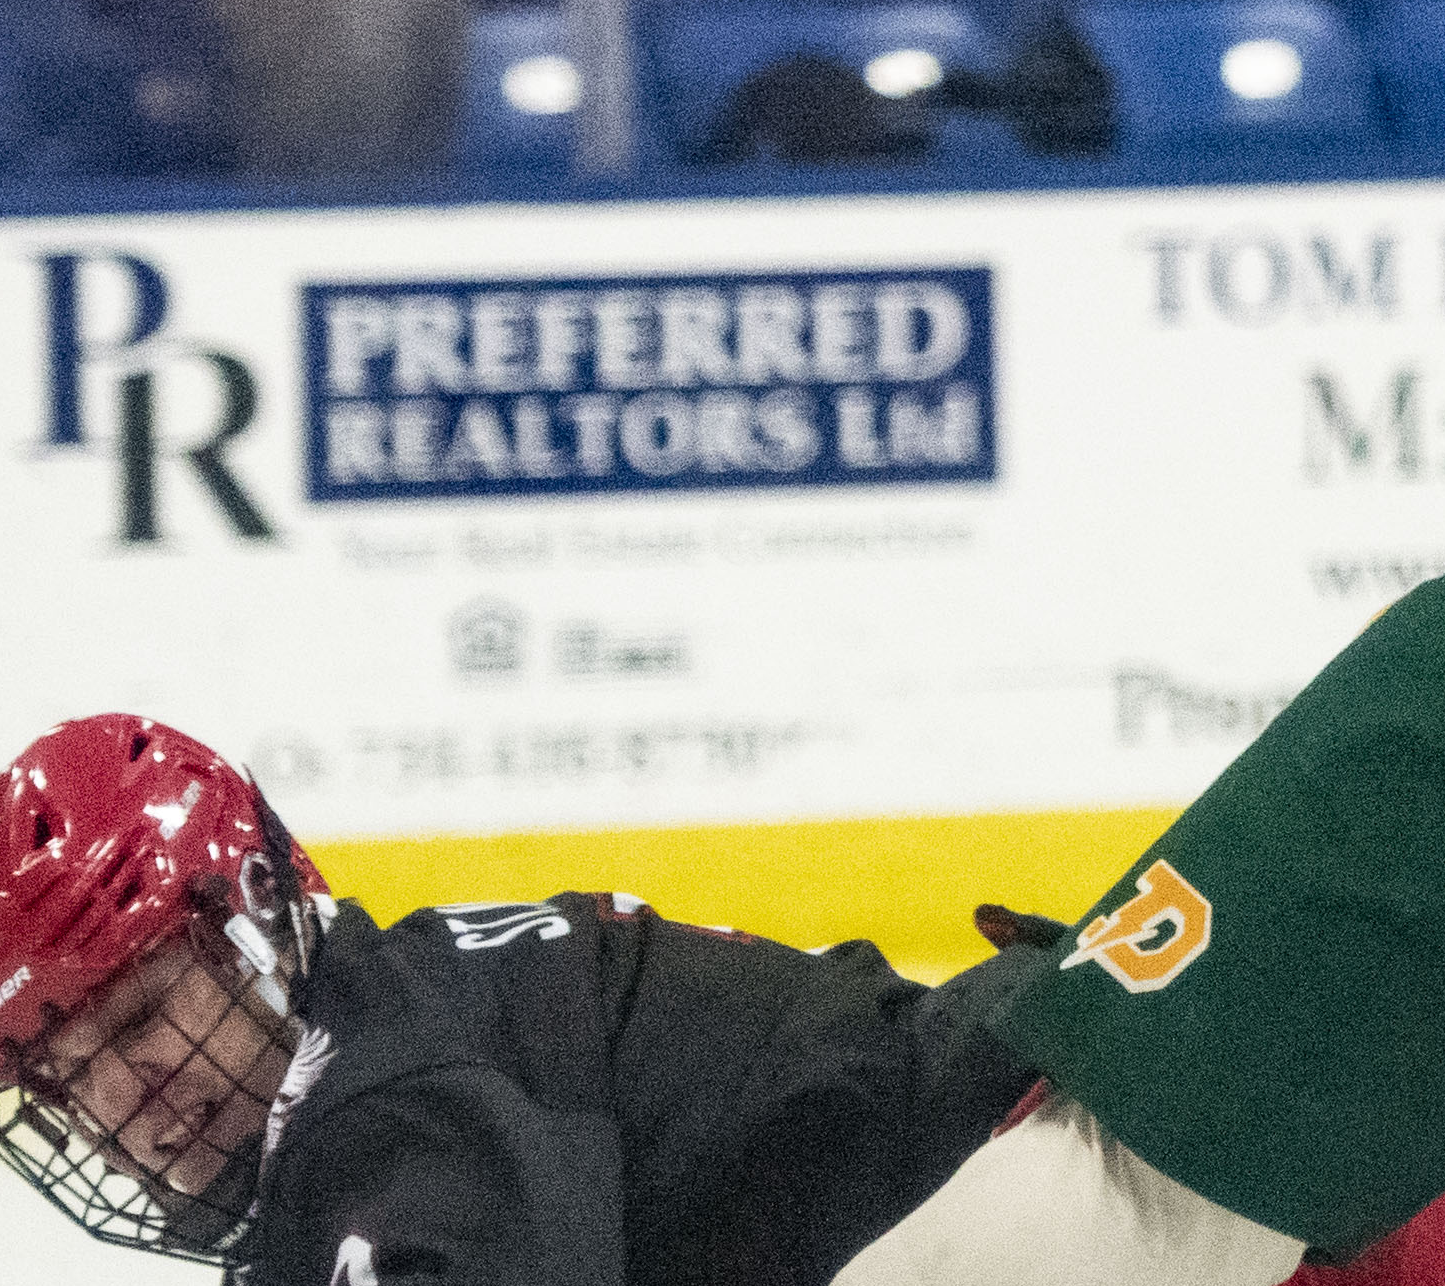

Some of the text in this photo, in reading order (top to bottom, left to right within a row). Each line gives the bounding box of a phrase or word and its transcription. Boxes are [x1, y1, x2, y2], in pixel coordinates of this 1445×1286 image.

[1133, 222, 1401, 328] TOM
[325, 282, 969, 394] PREFERRED
[323, 384, 823, 486] REALTORS
